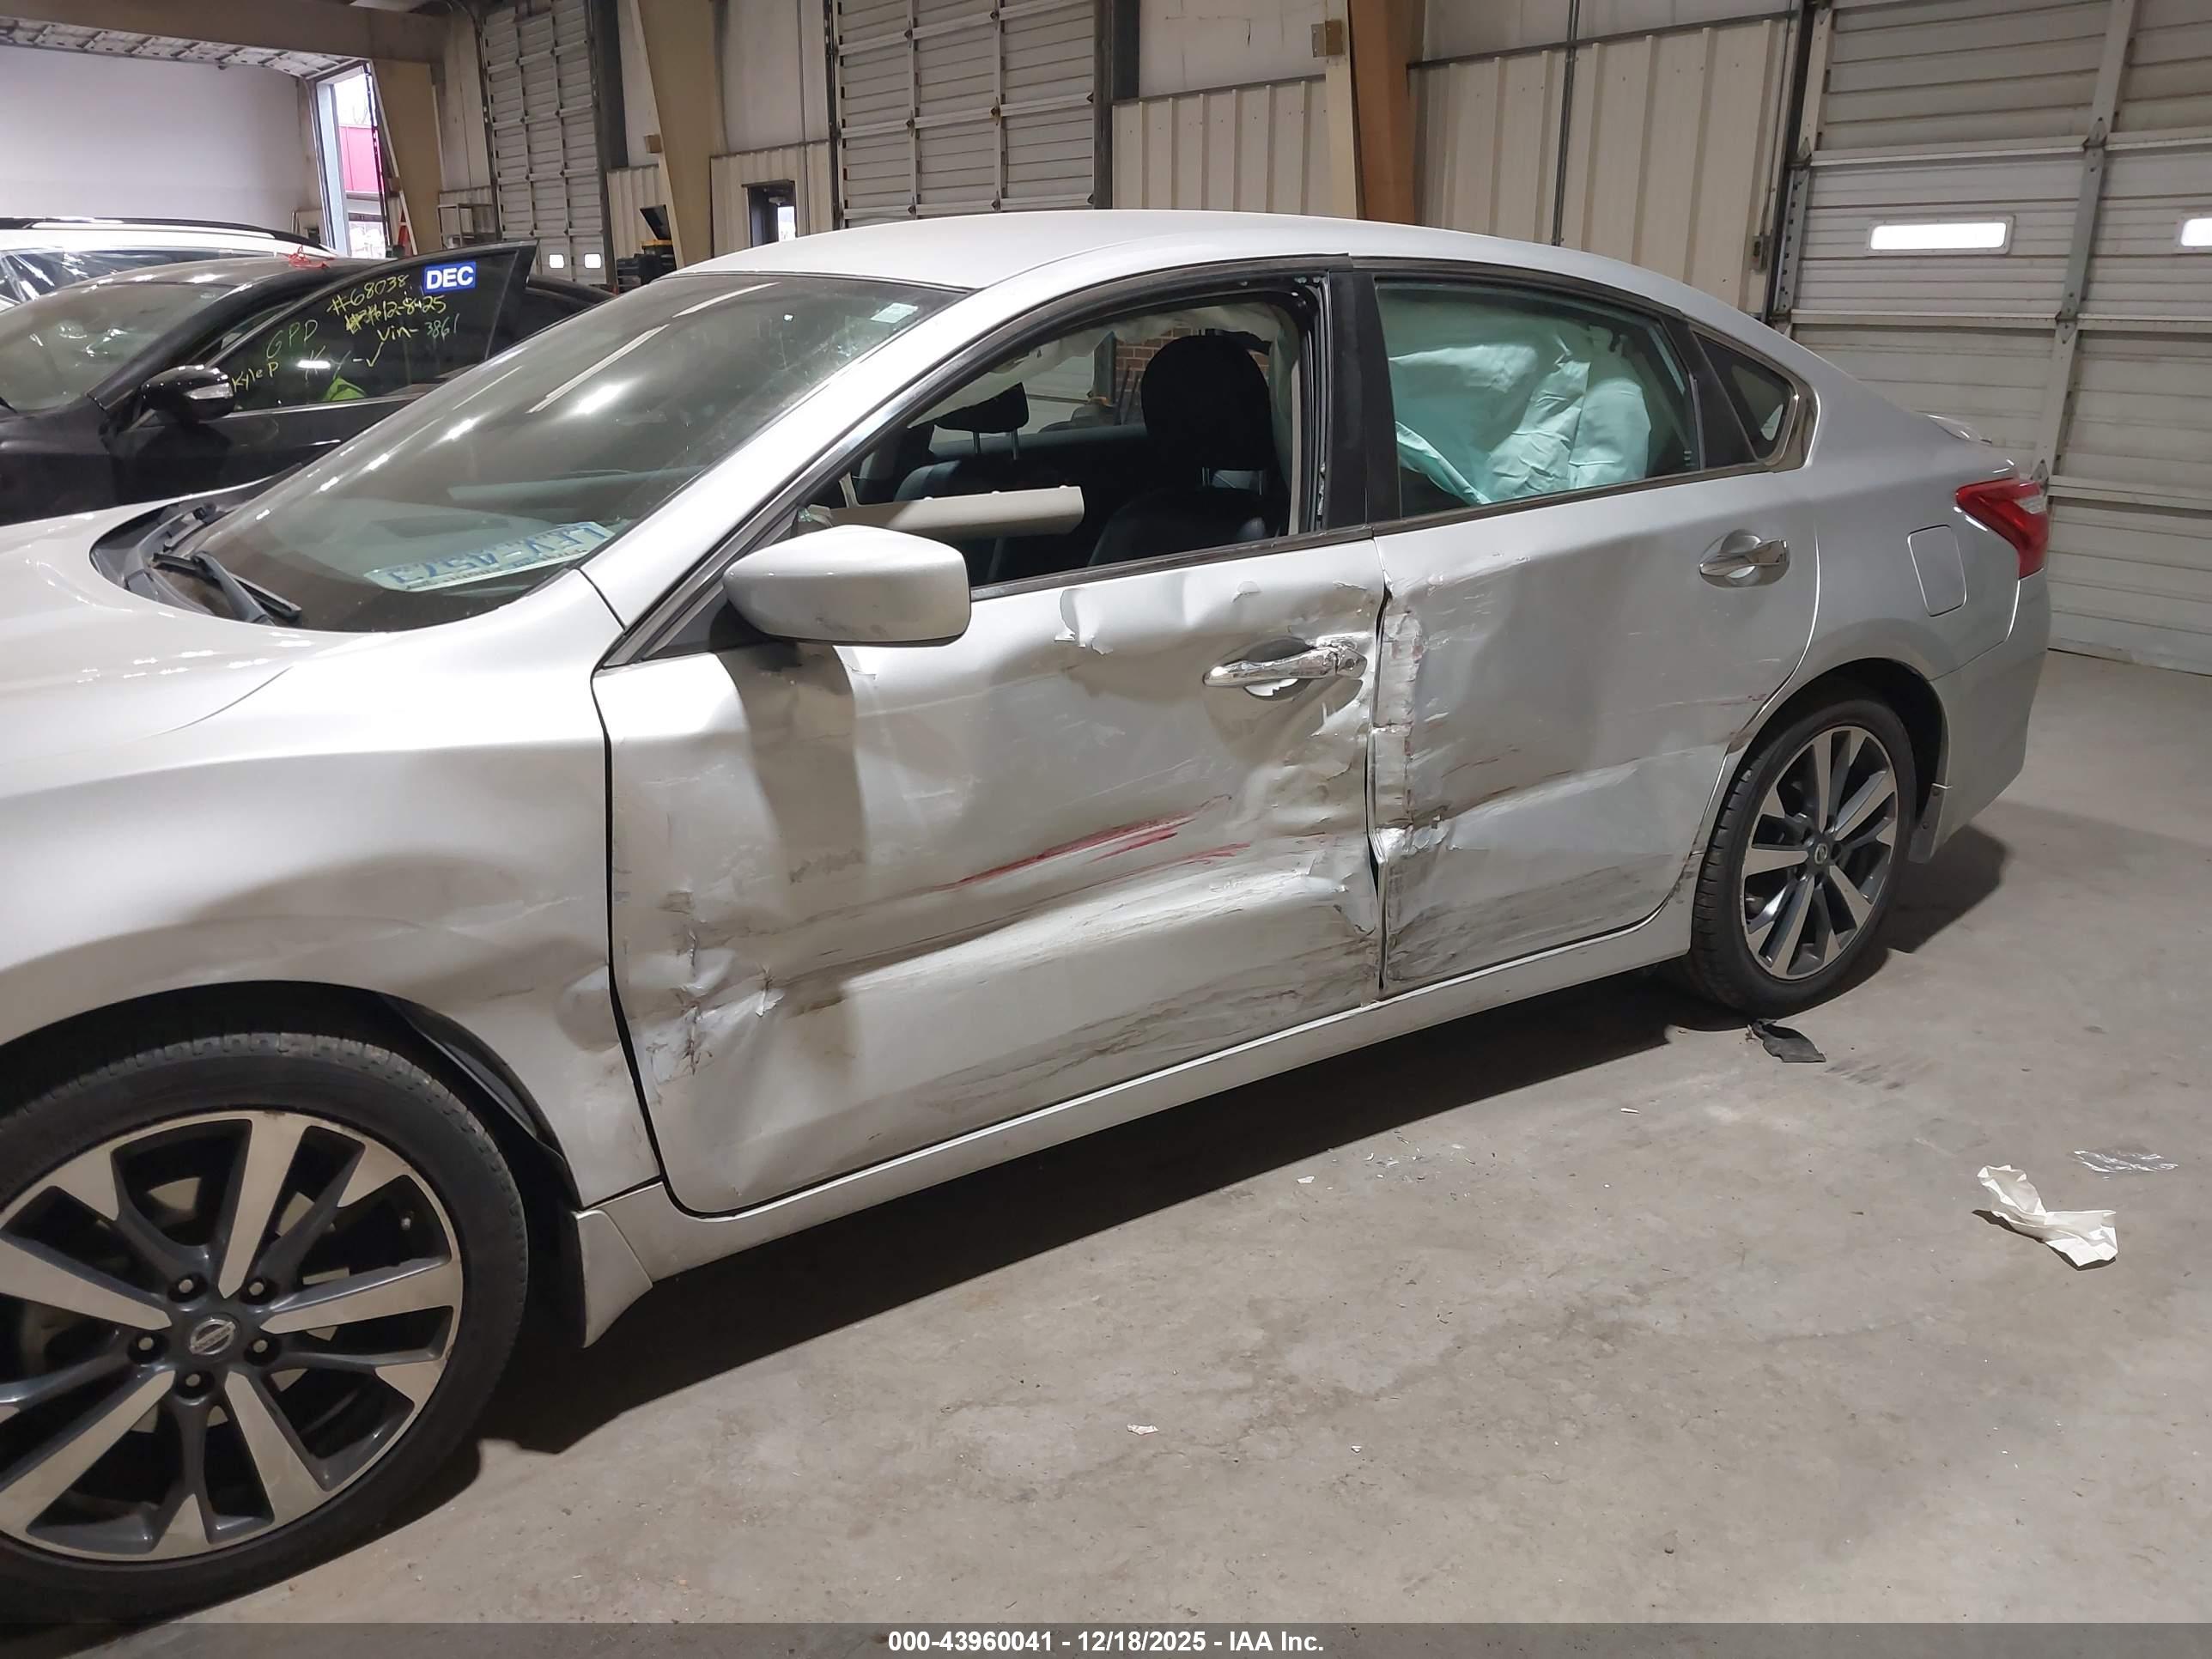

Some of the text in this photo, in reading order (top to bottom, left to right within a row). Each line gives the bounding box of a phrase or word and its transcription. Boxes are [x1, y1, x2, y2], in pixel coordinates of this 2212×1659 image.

[427, 266, 474, 289] DEC
[326, 275, 410, 315] #68038
[266, 319, 319, 360] GPD
[268, 362, 279, 378] P
